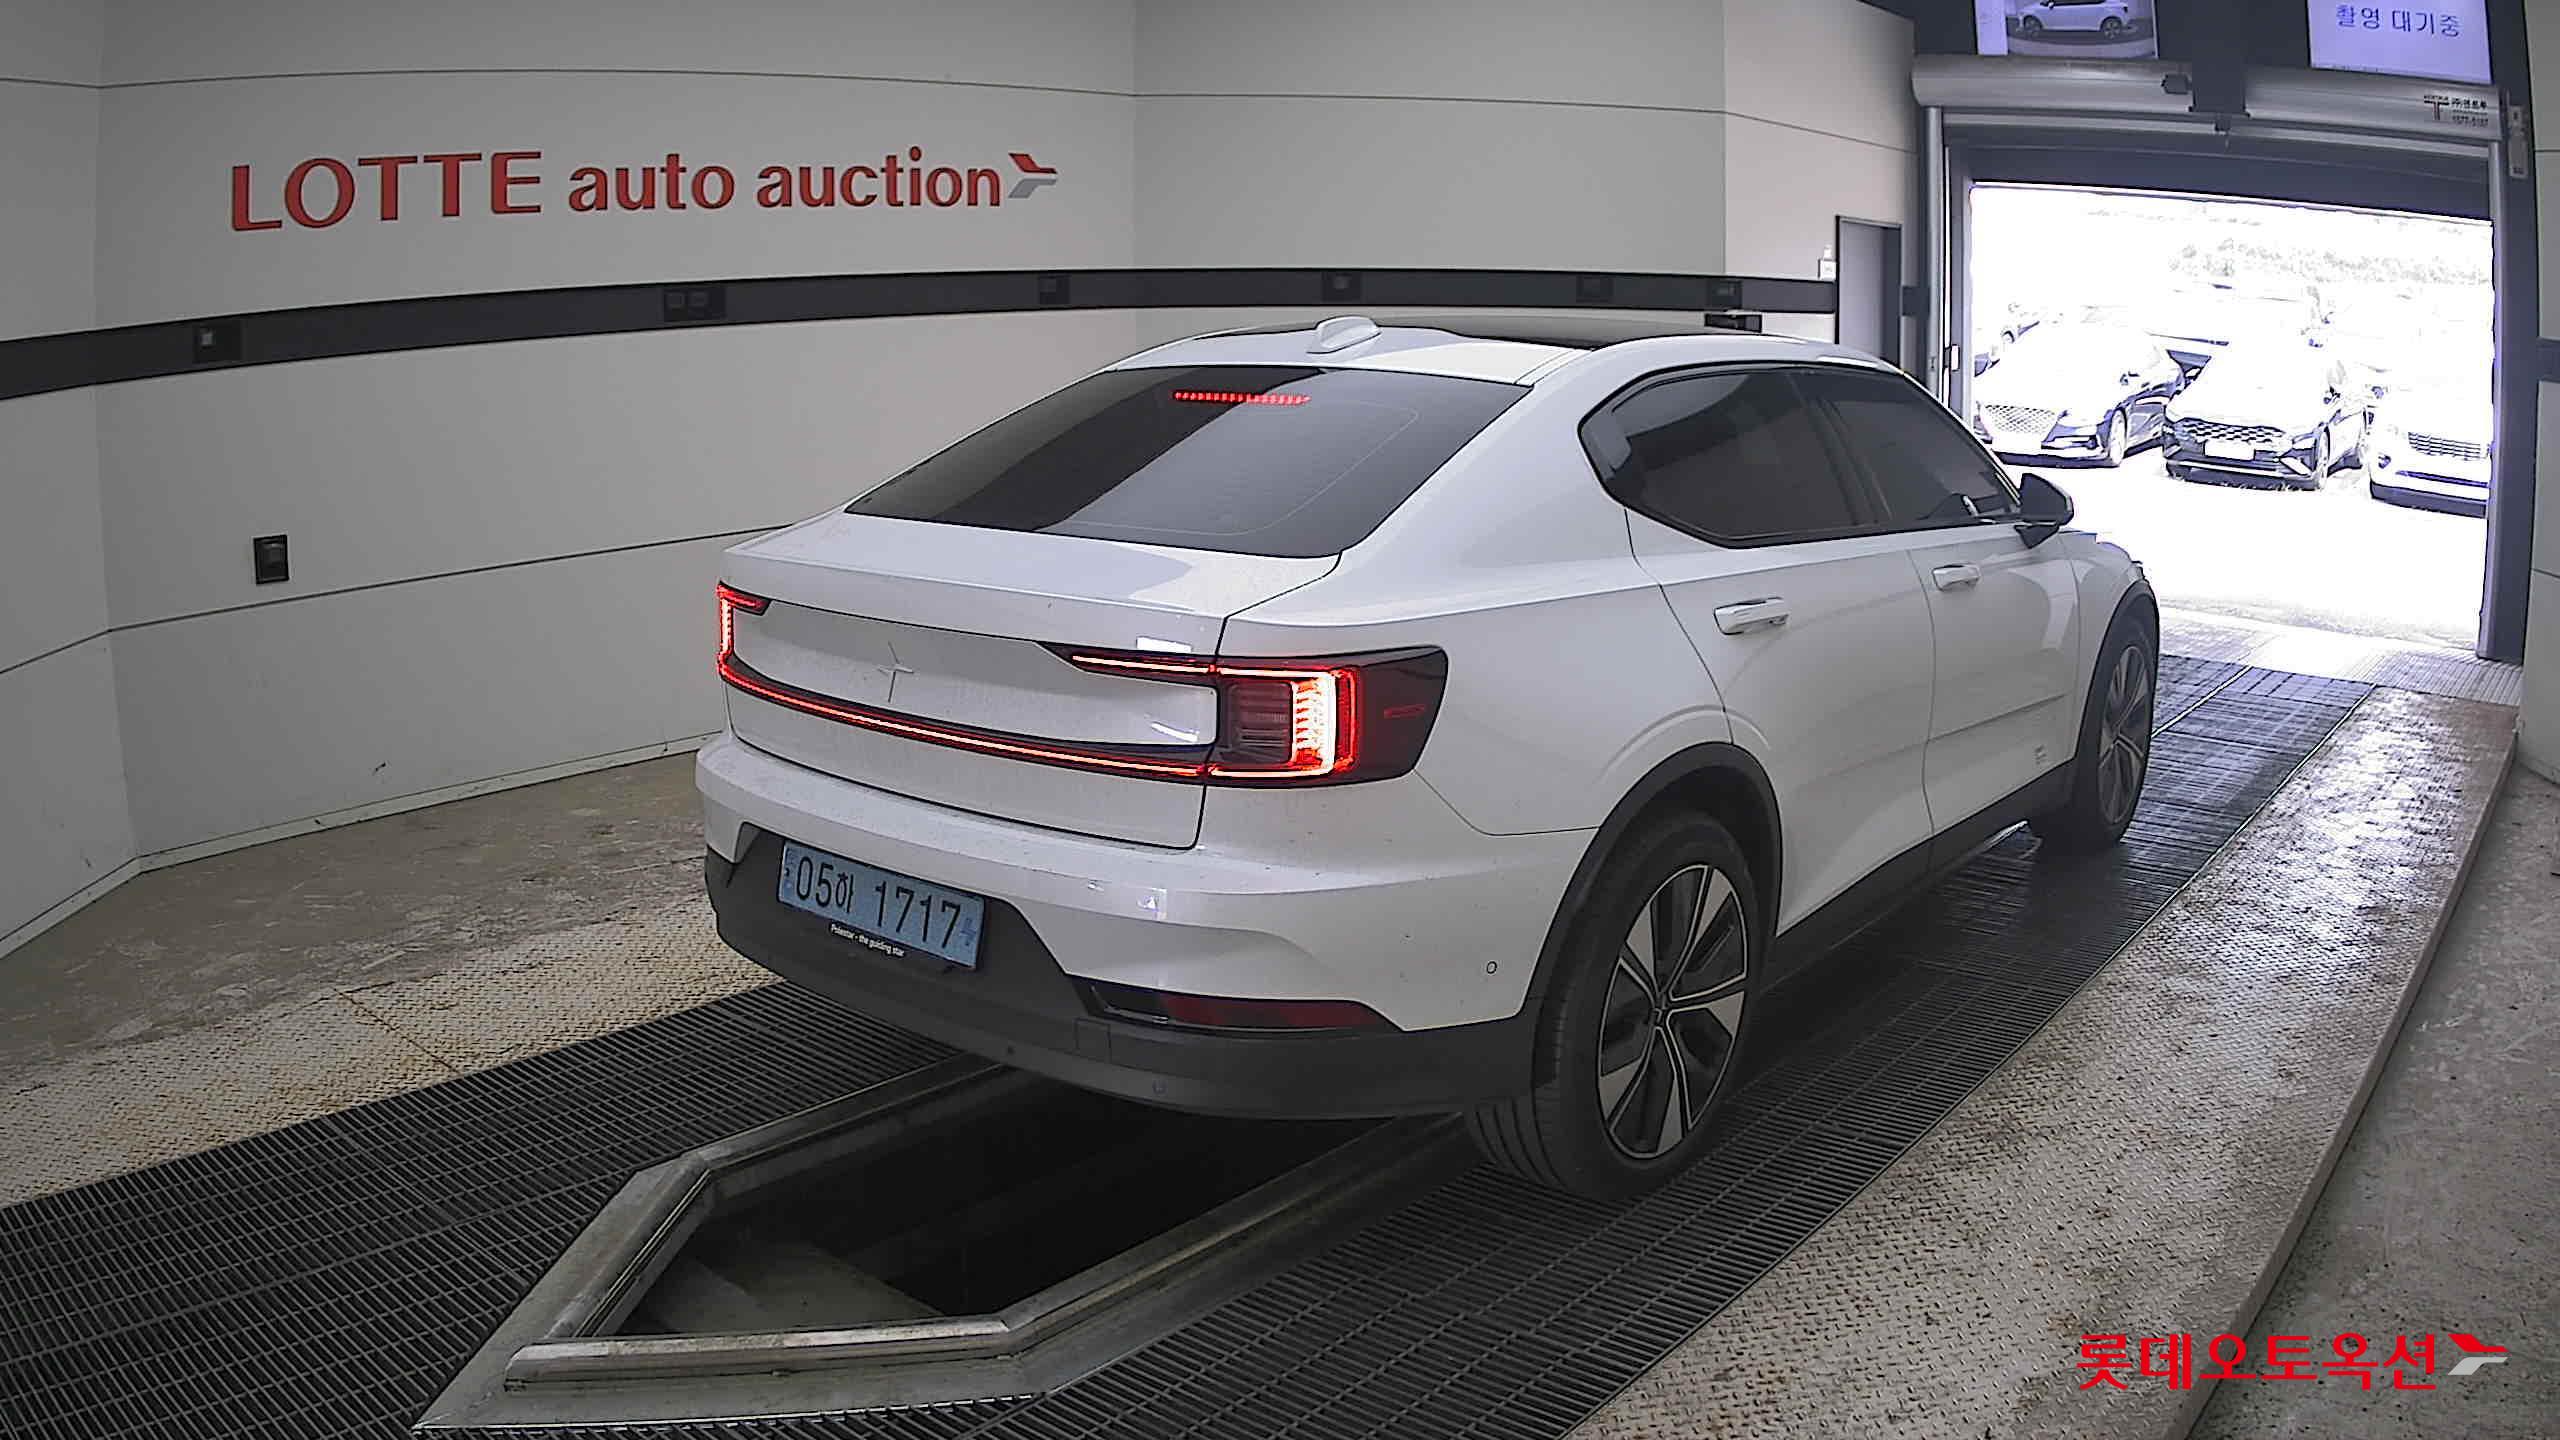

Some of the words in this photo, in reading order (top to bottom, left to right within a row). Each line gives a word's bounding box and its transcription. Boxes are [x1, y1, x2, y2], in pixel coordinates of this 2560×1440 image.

[2336, 4, 2381, 30] 촬영
[2391, 9, 2461, 38] 대기중
[231, 151, 542, 232] LOTTE
[568, 153, 736, 212] auto
[756, 146, 1001, 208] auction
[795, 855, 855, 914] 05하
[874, 879, 962, 950] 1717
